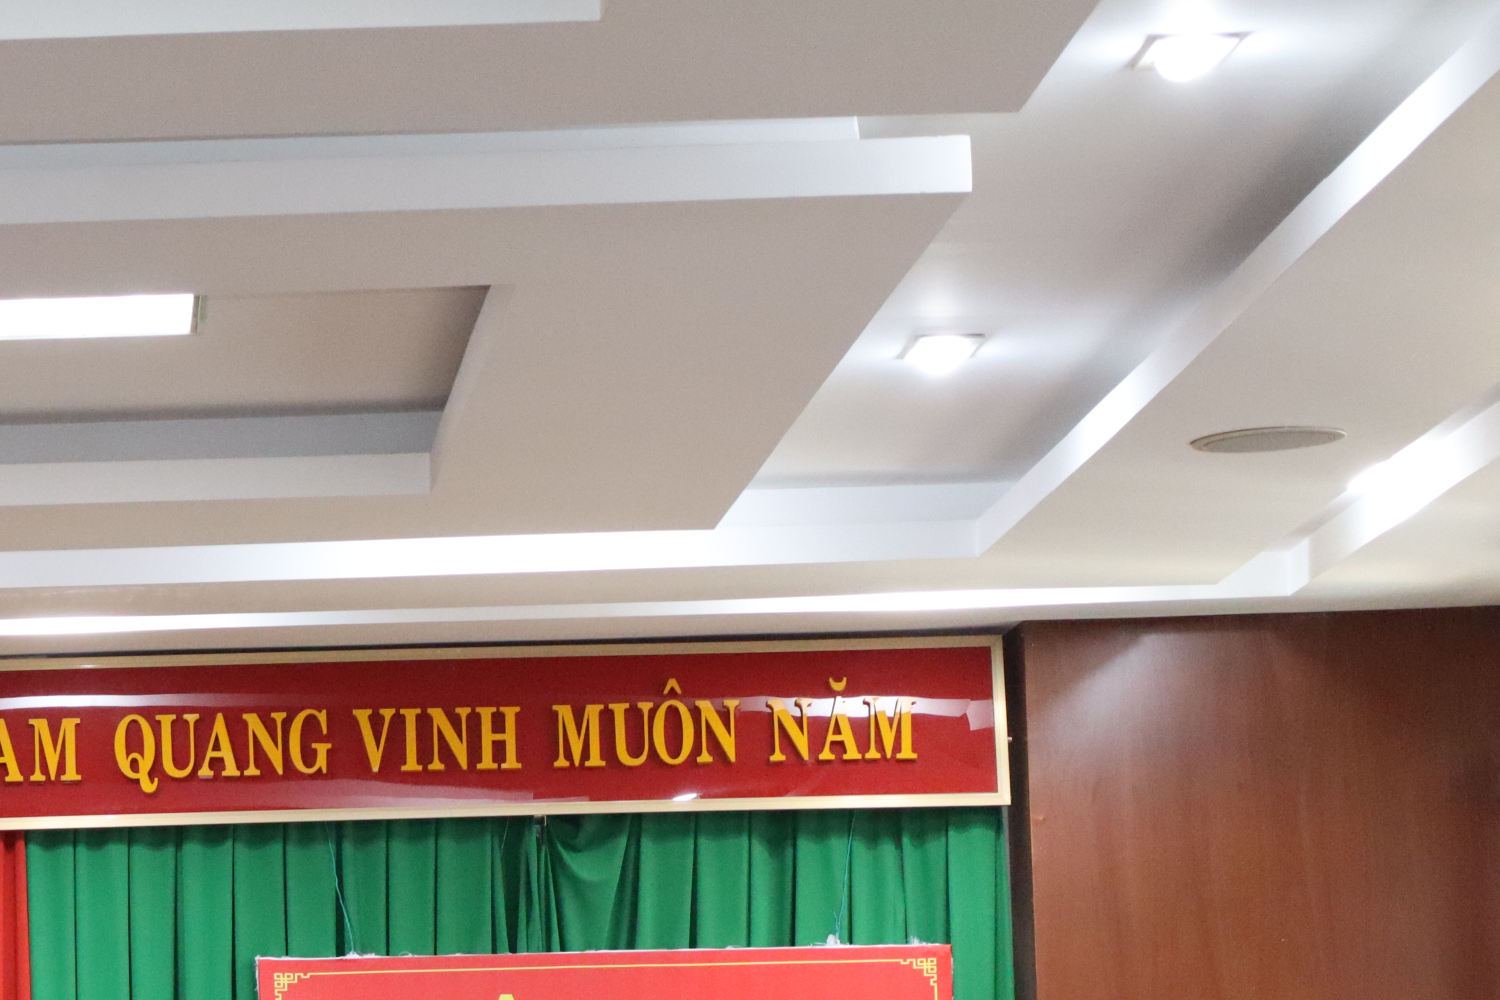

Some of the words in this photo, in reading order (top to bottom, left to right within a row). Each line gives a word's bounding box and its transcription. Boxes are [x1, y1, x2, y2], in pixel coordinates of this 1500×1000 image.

[116, 708, 332, 794] QUANG
[353, 705, 522, 772] VINH
[553, 678, 741, 769] MUÔN
[768, 676, 919, 764] NĂM
